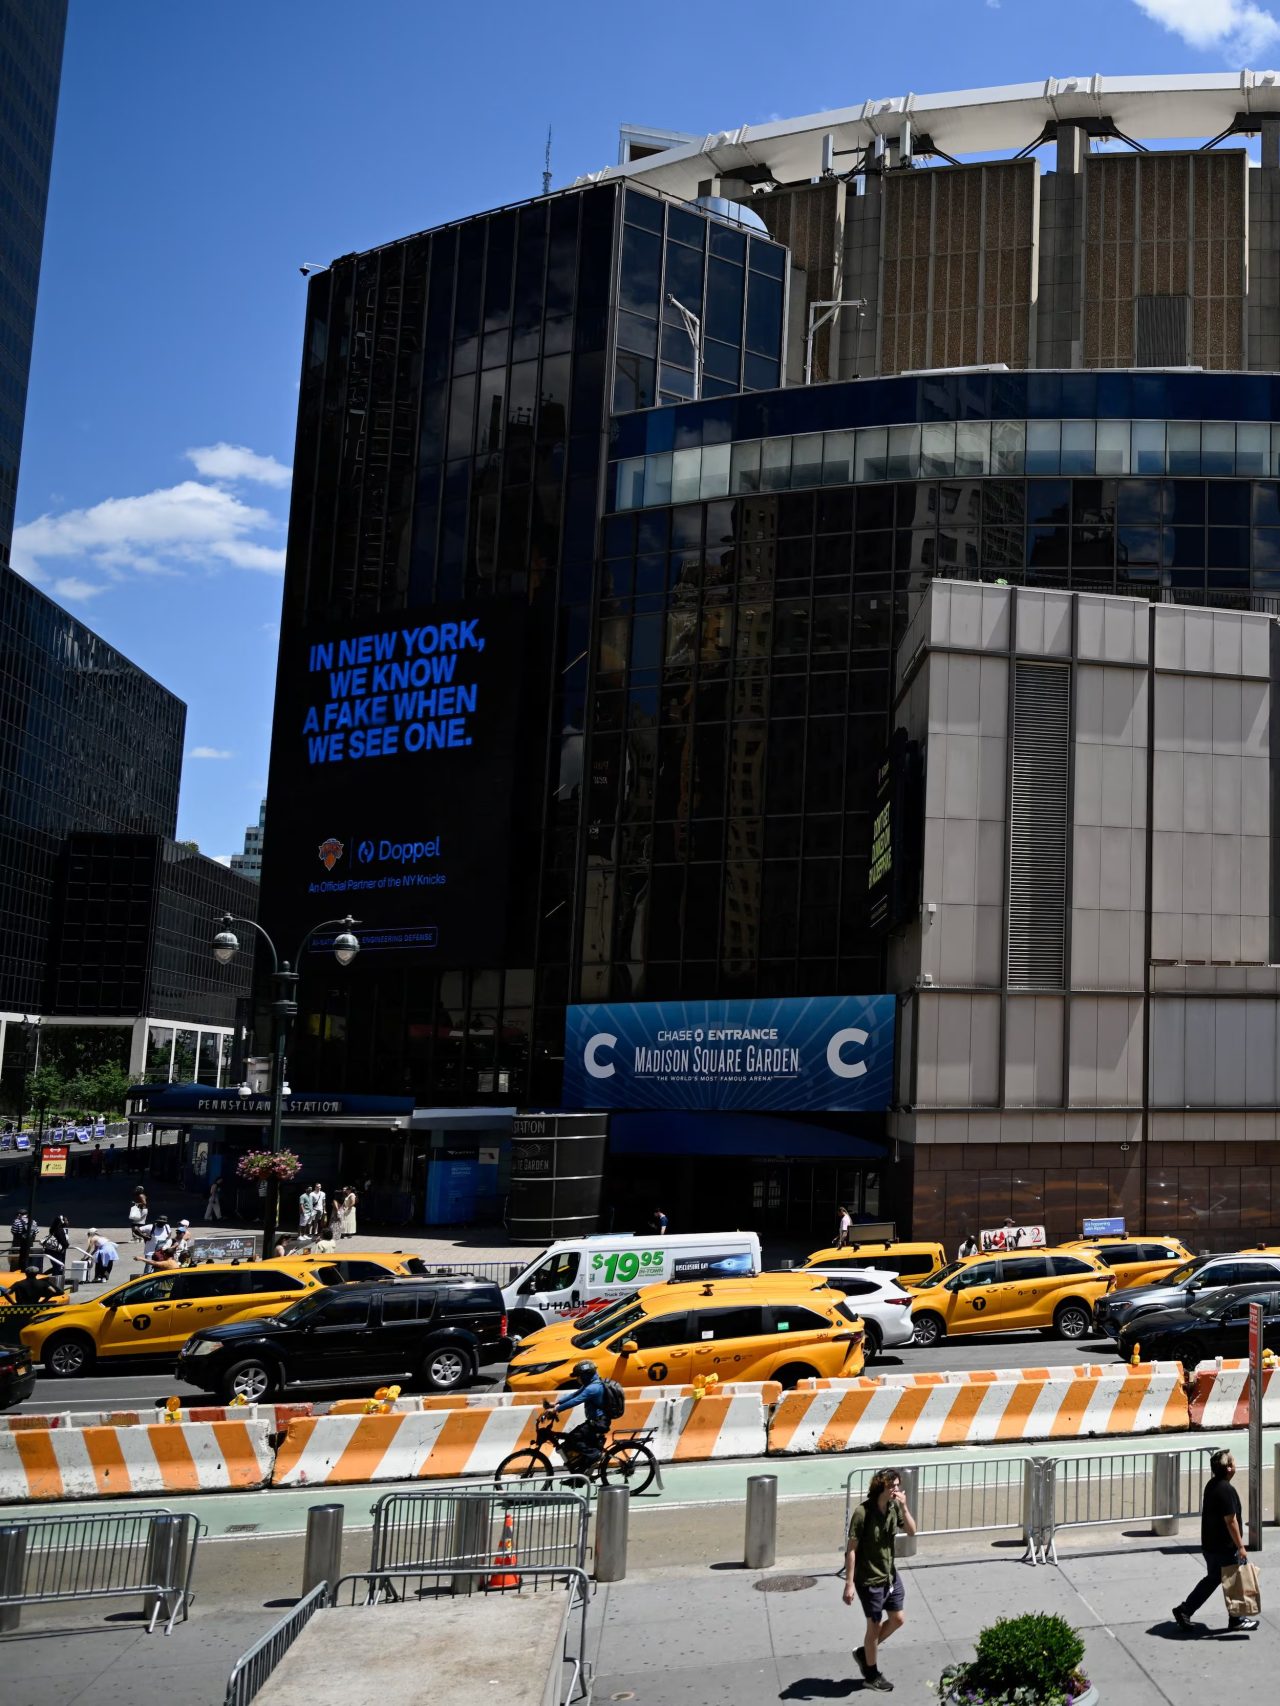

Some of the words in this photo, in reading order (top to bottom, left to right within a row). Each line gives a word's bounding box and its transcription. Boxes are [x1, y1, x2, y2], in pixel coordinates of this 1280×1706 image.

[308, 642, 335, 672] IN
[338, 631, 397, 668] NEW
[401, 618, 486, 657] YORK,
[329, 667, 368, 699] WE
[371, 654, 458, 693] KNOW
[302, 706, 319, 734] A
[323, 696, 388, 732] FAKE
[393, 683, 478, 721] WHEN
[307, 733, 345, 765] WE
[348, 725, 400, 759] SEE
[404, 717, 473, 752] ONE.
[378, 835, 441, 865] Doppel
[308, 883, 320, 894] An
[320, 881, 346, 892] Official
[347, 880, 377, 891] Partner
[377, 877, 386, 888] of
[386, 876, 401, 887] the
[402, 875, 416, 887] NY
[417, 873, 446, 886] Knicks
[657, 1030, 693, 1041] CHASE
[707, 1028, 778, 1041] ENTRANCE
[583, 1032, 618, 1079] C
[634, 1046, 690, 1073] MADISON
[692, 1045, 742, 1073] SQUARE
[826, 1027, 870, 1079] C
[290, 1100, 340, 1113] STATION
[523, 1158, 549, 1171] GARDEN
[1031, 1227, 1042, 1243] 2
